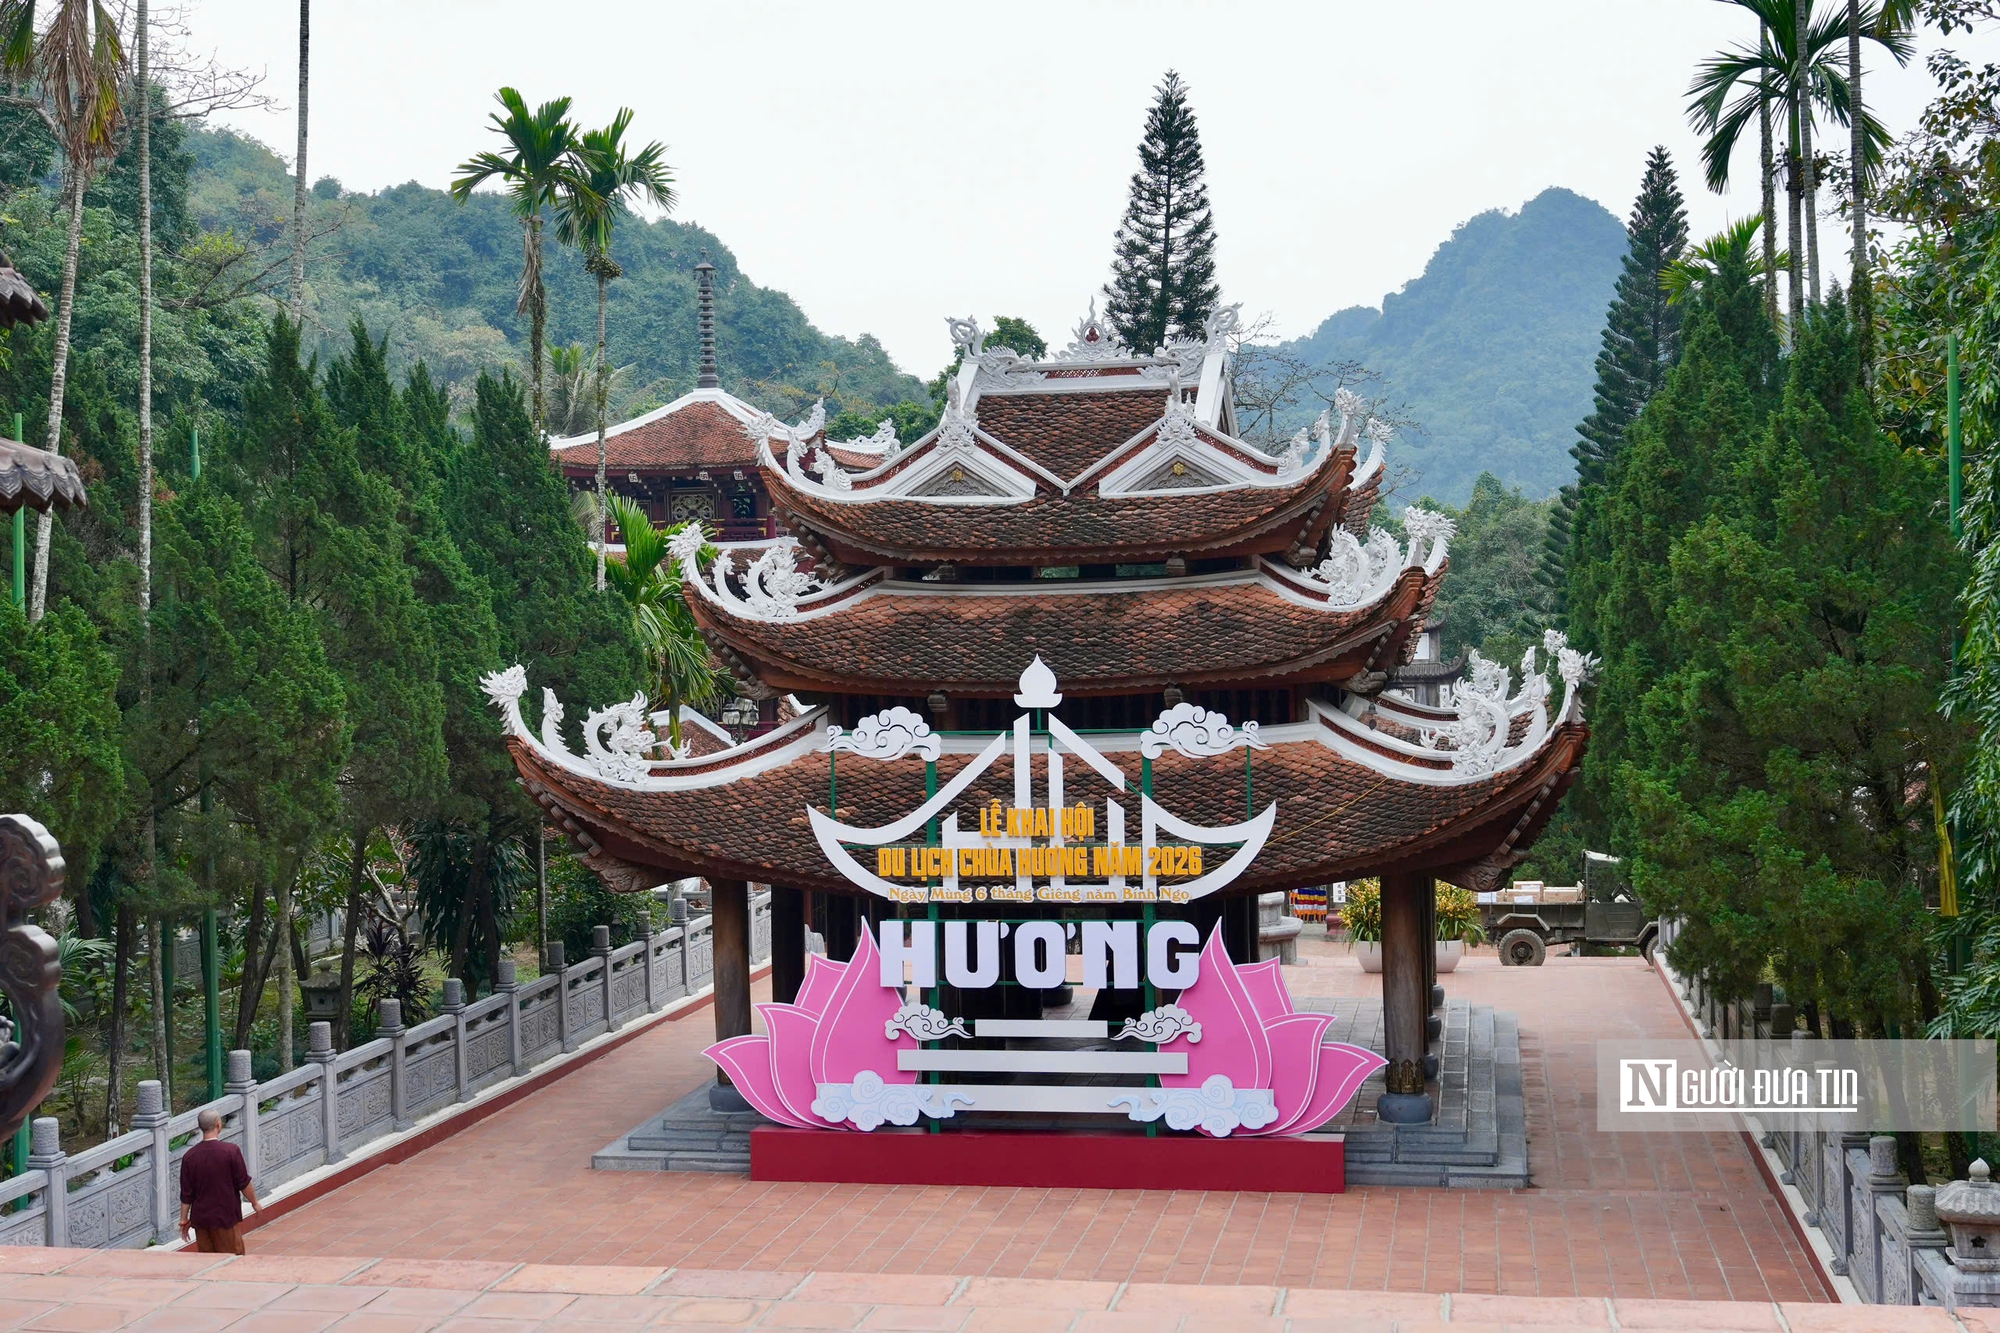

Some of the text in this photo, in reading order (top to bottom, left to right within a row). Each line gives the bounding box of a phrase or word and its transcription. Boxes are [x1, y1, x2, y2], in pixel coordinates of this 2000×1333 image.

[980, 798, 1095, 842] LỄ KHAI HỘI
[878, 841, 1203, 882] DU LỊCH CHÙA HƯƠNG NĂM 2026
[888, 885, 1192, 904] Ngày Mùng 6 tháng Giêng năm Bính Ngọ
[879, 920, 1200, 990] HƯƠNG
